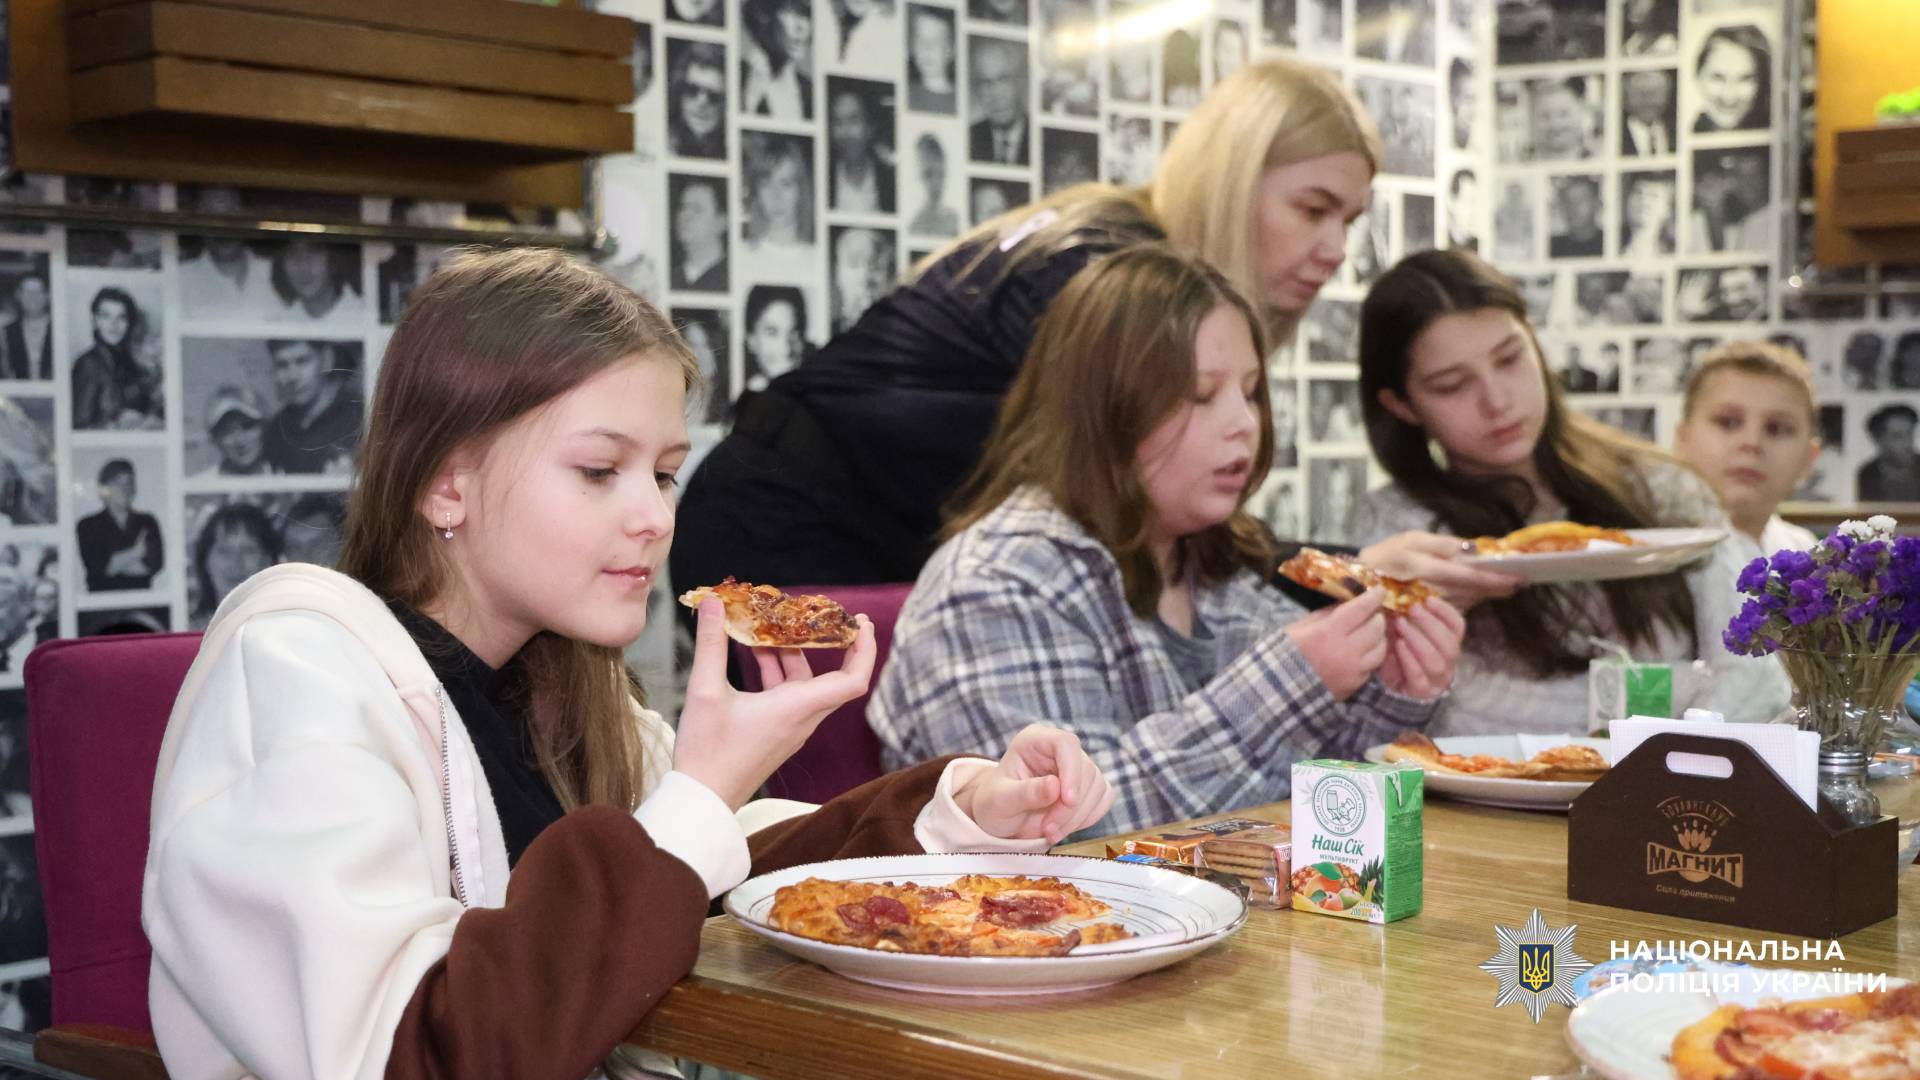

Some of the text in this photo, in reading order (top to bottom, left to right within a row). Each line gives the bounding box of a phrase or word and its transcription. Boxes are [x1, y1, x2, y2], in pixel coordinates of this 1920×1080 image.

[1312, 834, 1364, 856] Наш Сік
[1648, 844, 1741, 884] МАГНИТ
